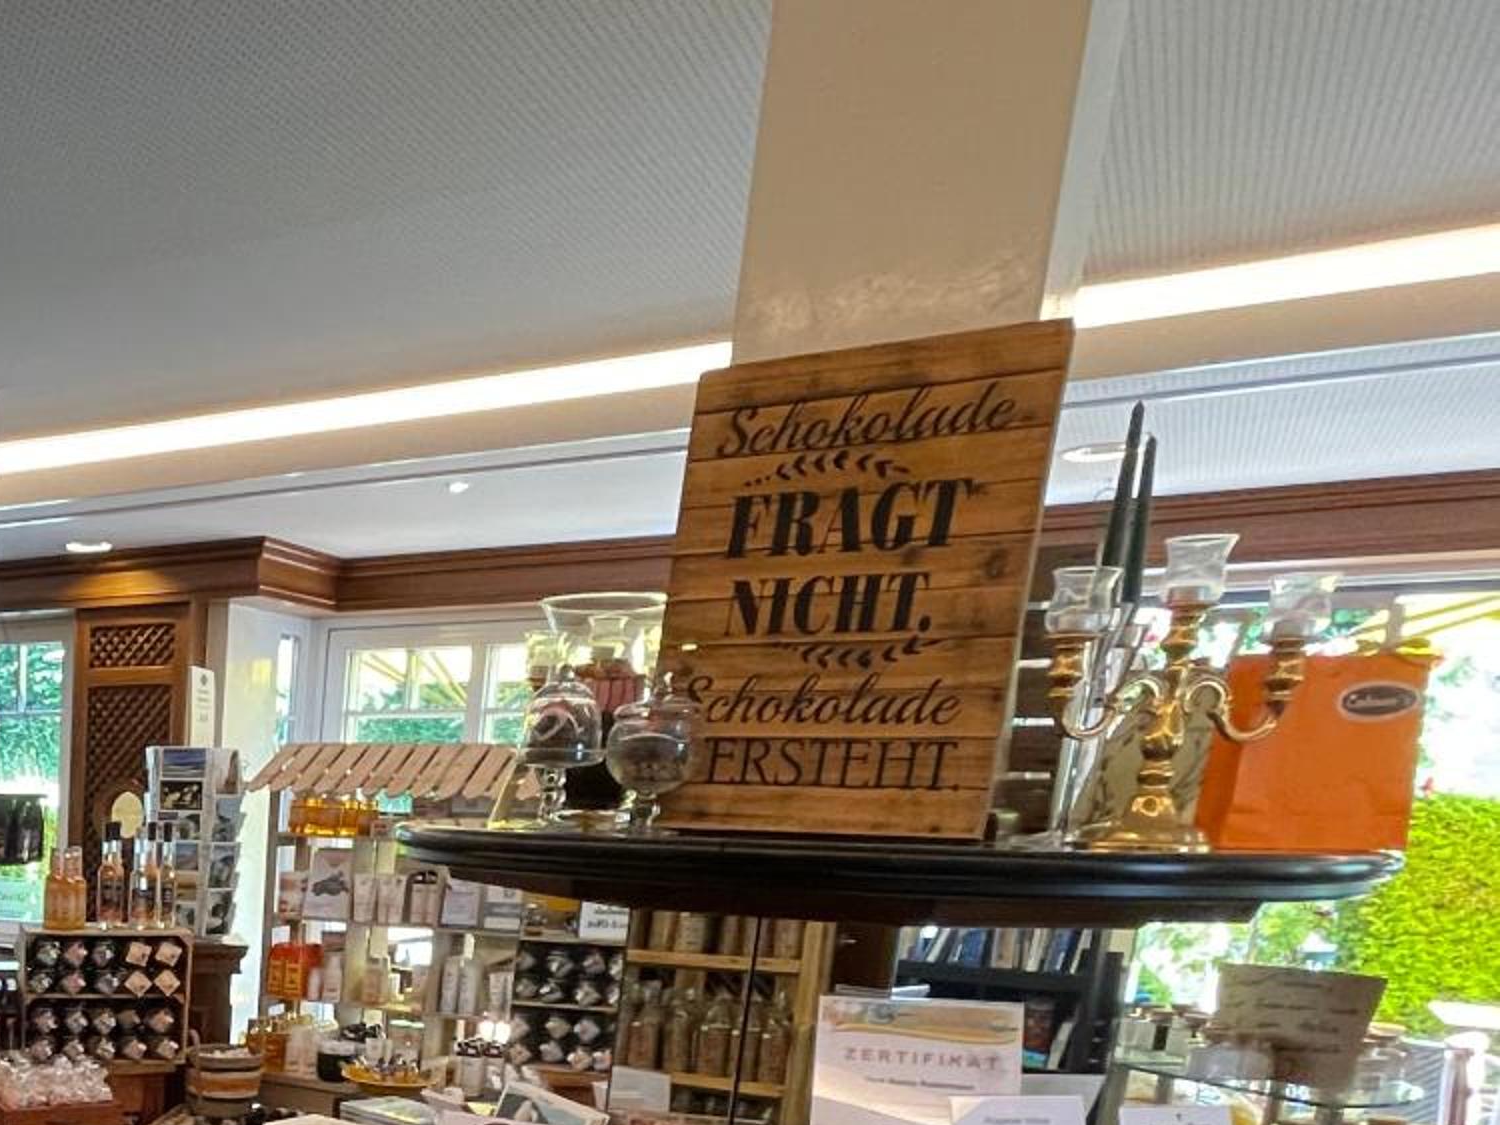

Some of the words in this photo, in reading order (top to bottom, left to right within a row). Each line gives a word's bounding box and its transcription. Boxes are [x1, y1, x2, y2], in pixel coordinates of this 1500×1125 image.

[716, 382, 1015, 457] Schokolade
[726, 478, 976, 559] FRAGT
[724, 573, 931, 637] NICHT.
[686, 673, 962, 726] Schokolade
[703, 737, 960, 790] ERSTEHT.
[845, 1047, 1000, 1071] ZERTIFIKAT
